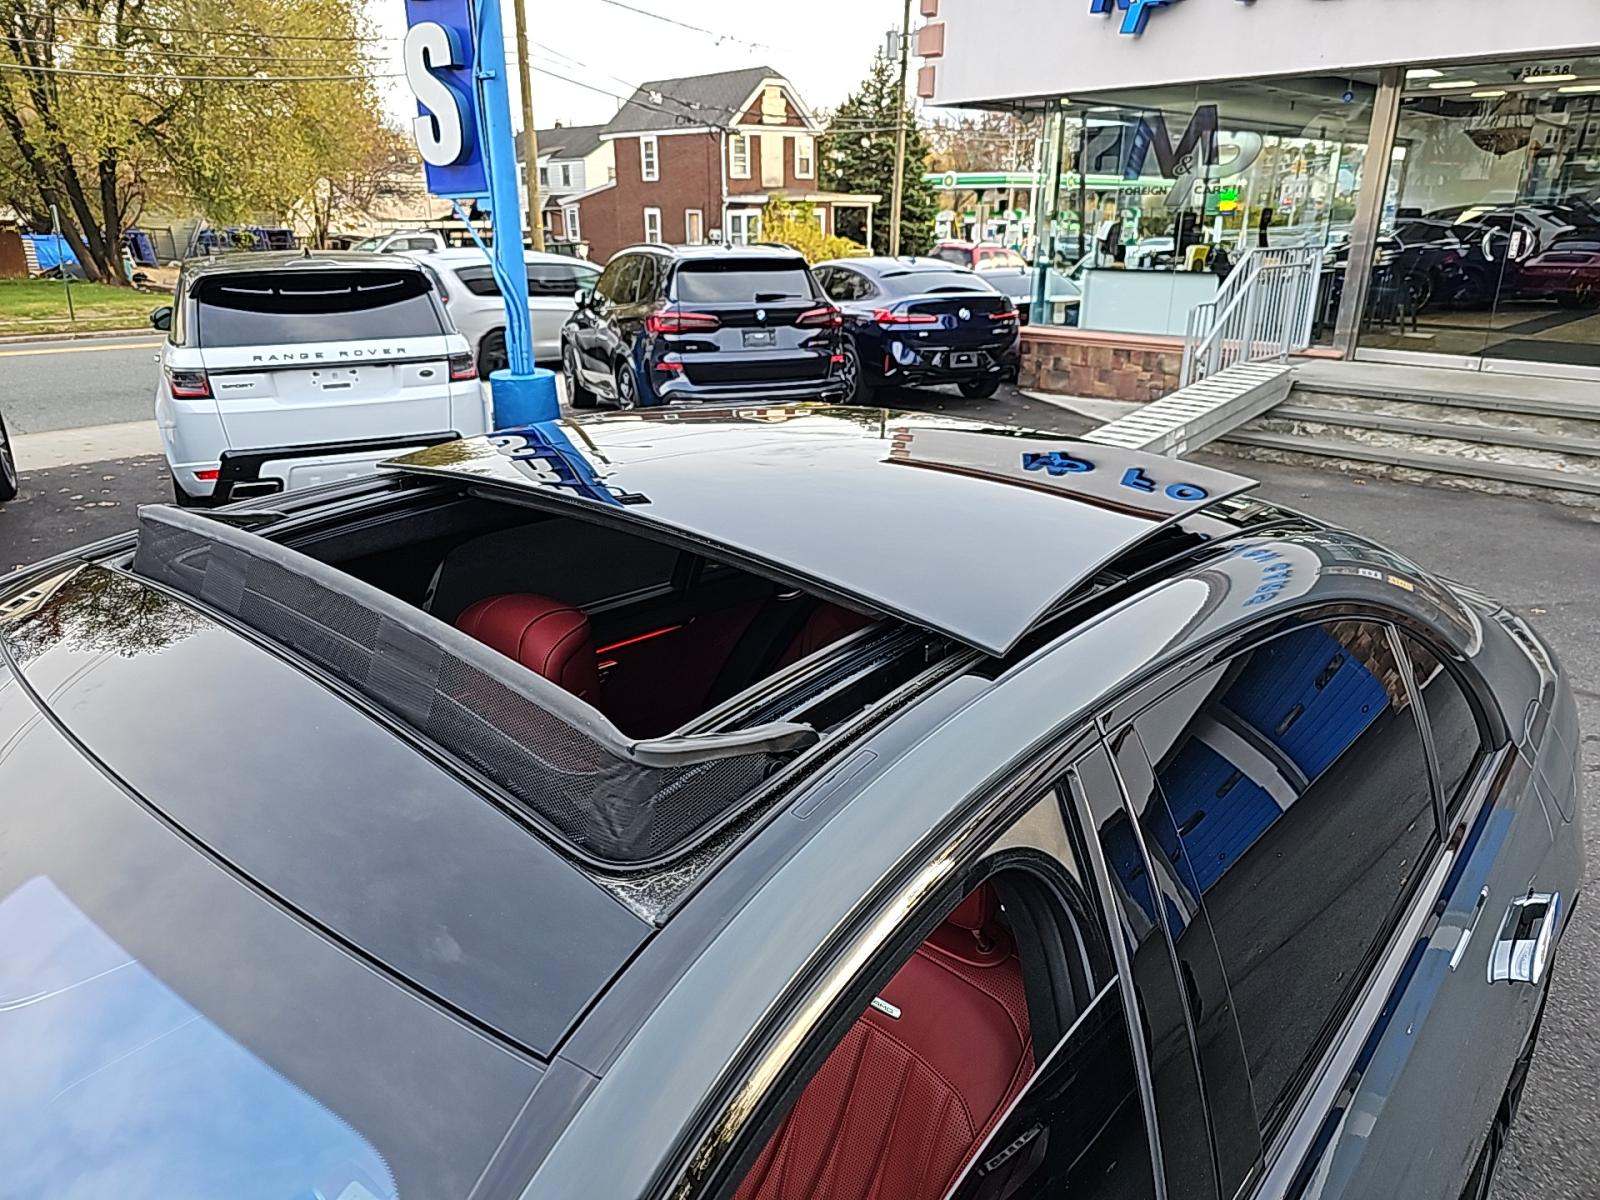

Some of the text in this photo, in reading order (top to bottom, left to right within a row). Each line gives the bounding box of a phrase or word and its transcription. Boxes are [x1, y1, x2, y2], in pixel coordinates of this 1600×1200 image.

[1119, 185, 1168, 196] FOREIGN
[252, 347, 408, 363] RANGE ROVER
[221, 381, 256, 390] SPORT
